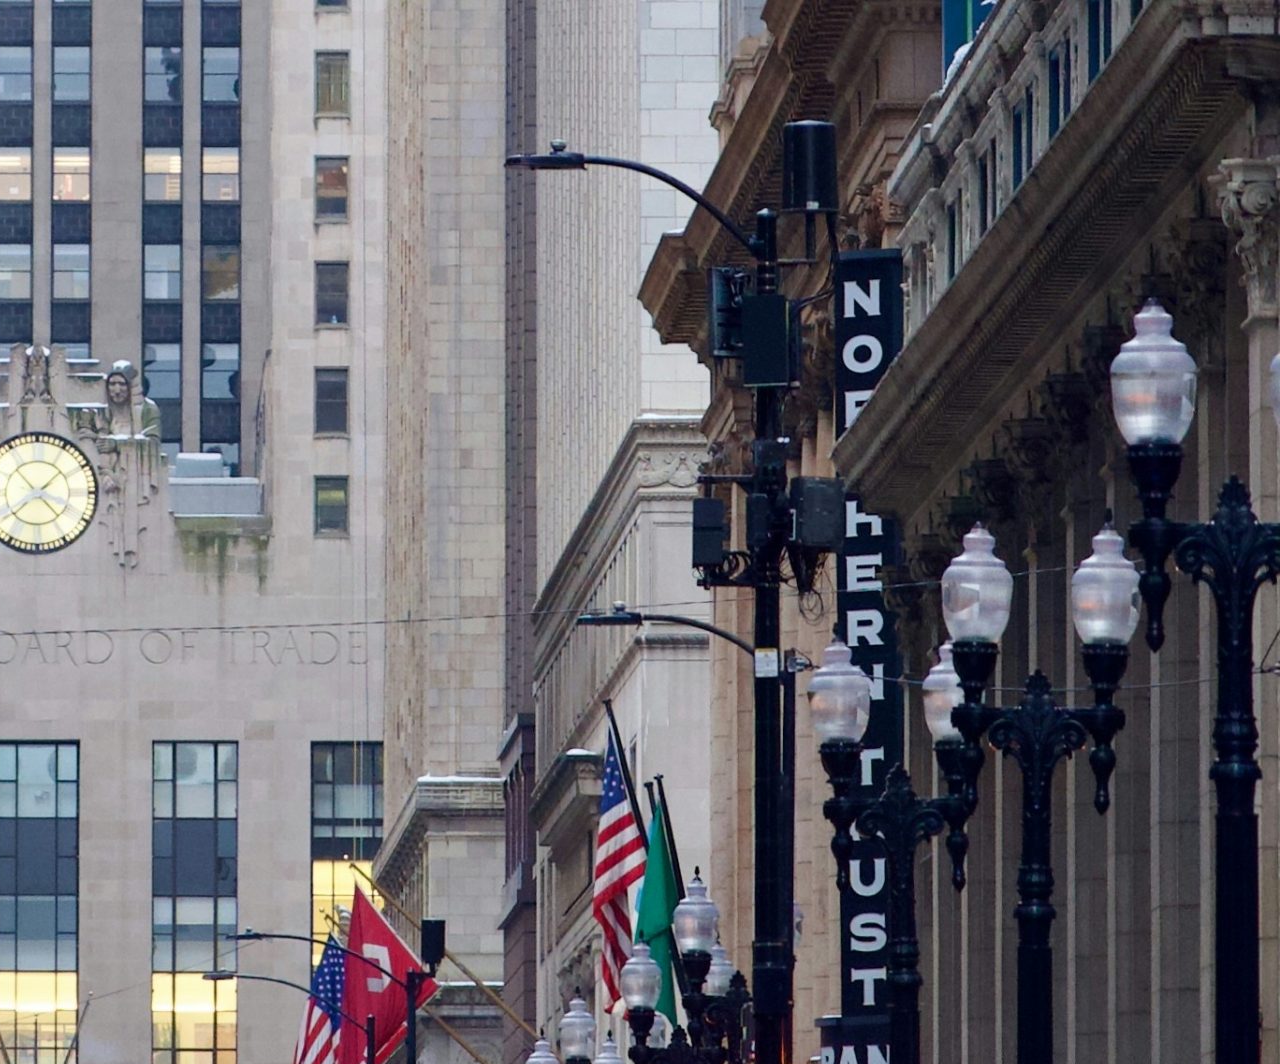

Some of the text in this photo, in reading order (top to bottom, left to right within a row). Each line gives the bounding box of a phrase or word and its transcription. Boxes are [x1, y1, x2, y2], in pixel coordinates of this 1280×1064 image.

[842, 279, 885, 701] NOHER
[138, 629, 196, 665] OF
[222, 628, 370, 665] TRADE
[848, 746, 888, 1007] TUST
